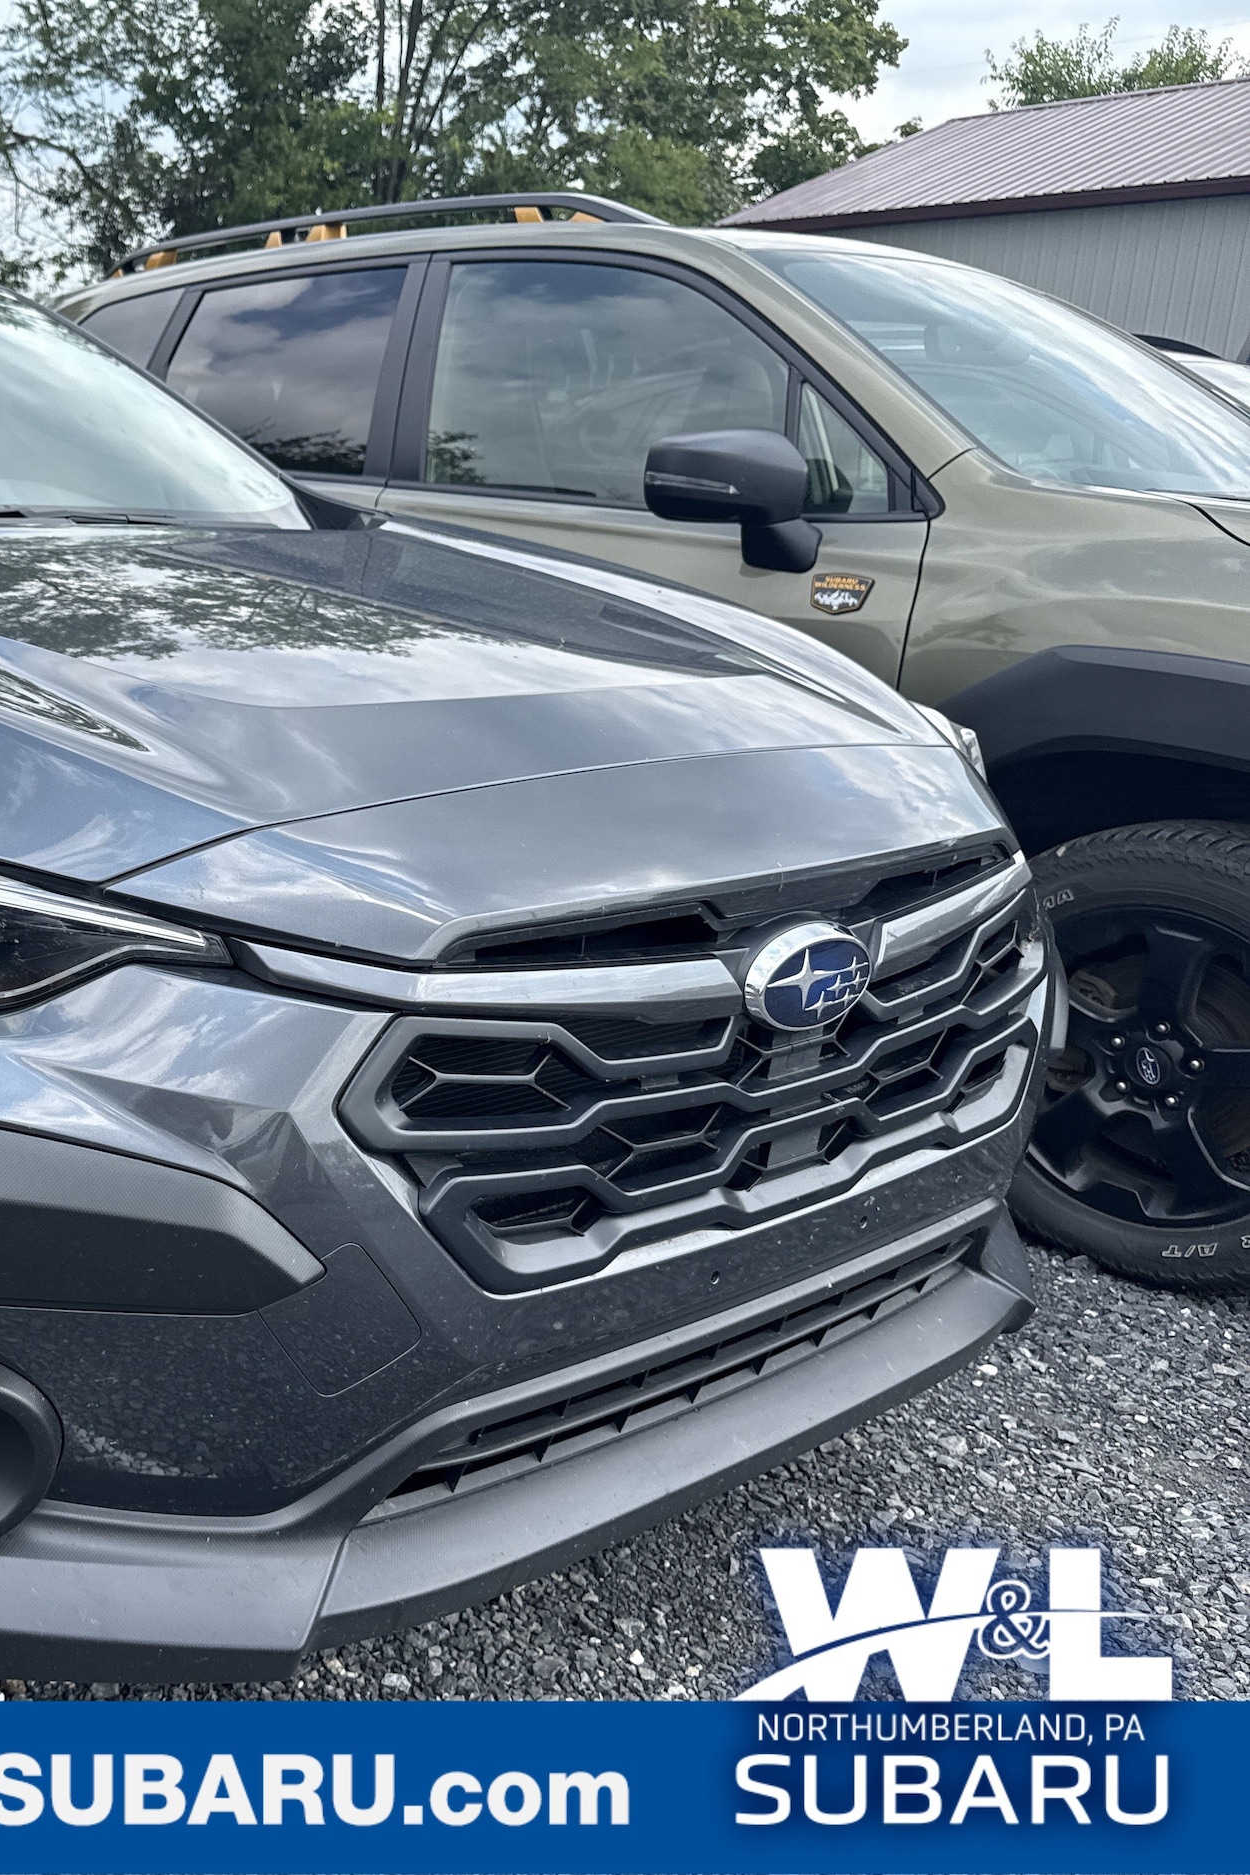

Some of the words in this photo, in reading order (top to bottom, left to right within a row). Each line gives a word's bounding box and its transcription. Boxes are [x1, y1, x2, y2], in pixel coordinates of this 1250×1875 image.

[825, 576, 859, 584] SUBARU
[814, 581, 866, 590] WILDERNESS
[1161, 1242, 1218, 1258] A/T
